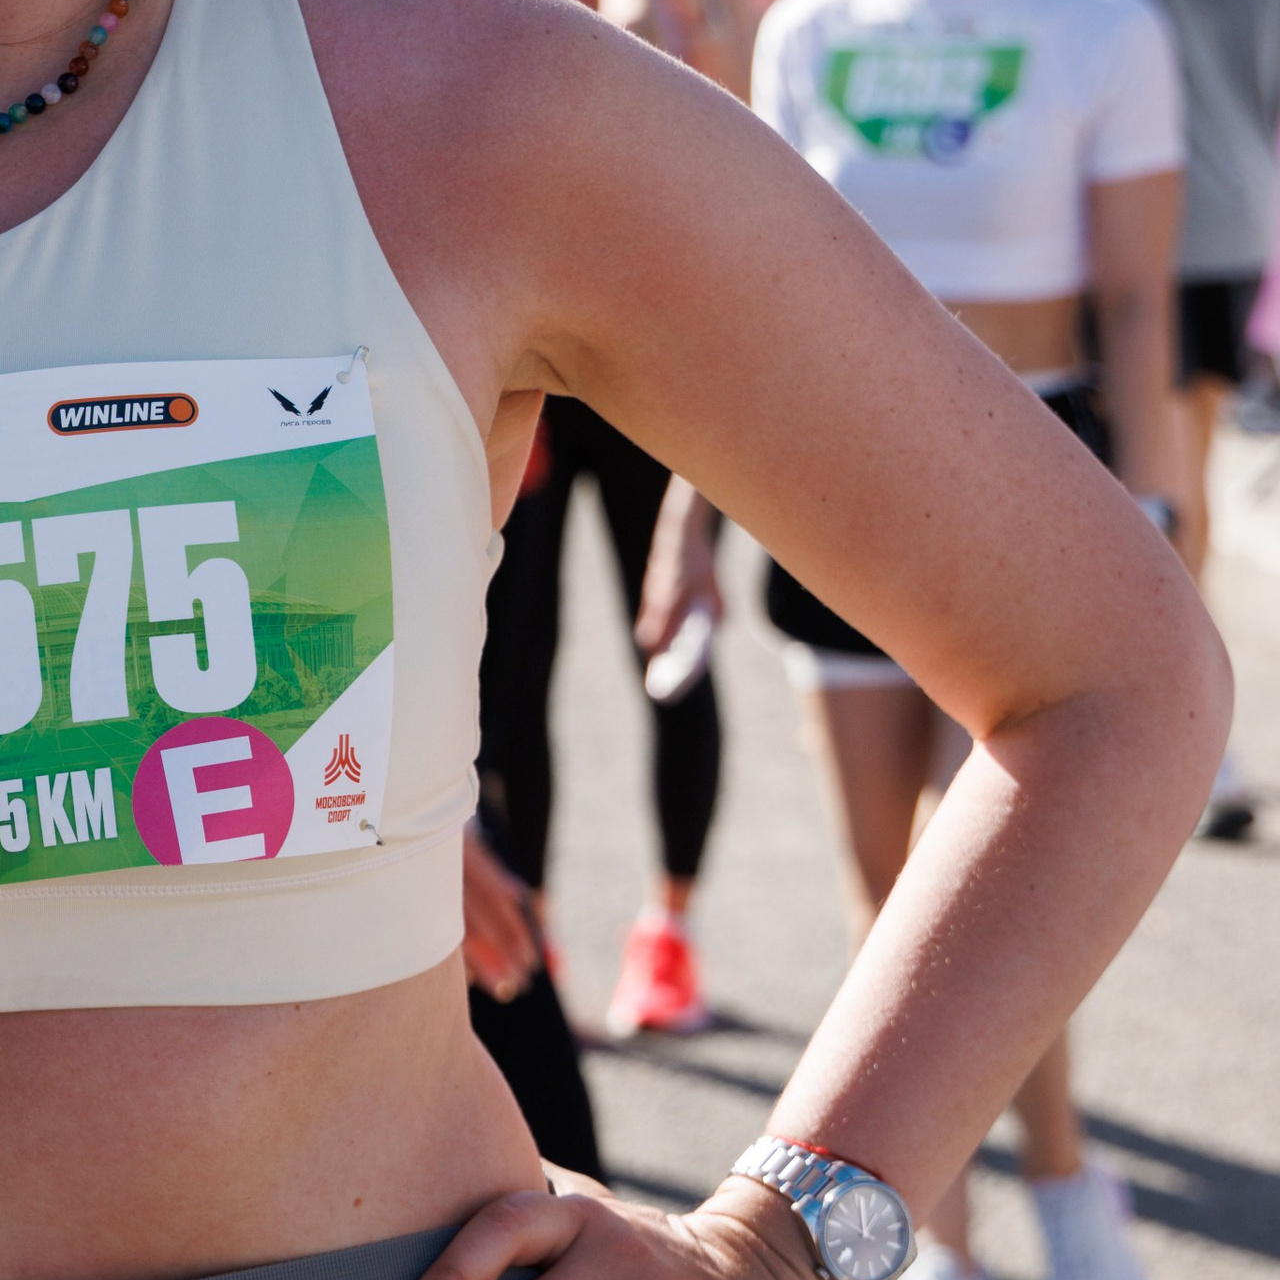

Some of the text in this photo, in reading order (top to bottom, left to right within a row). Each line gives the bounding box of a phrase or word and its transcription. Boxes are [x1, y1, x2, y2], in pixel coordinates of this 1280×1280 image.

[59, 401, 165, 428] WINLINE
[160, 735, 266, 866] E
[315, 790, 366, 810] МОСКОВСКИЙ
[327, 809, 352, 823] СПОРТ
